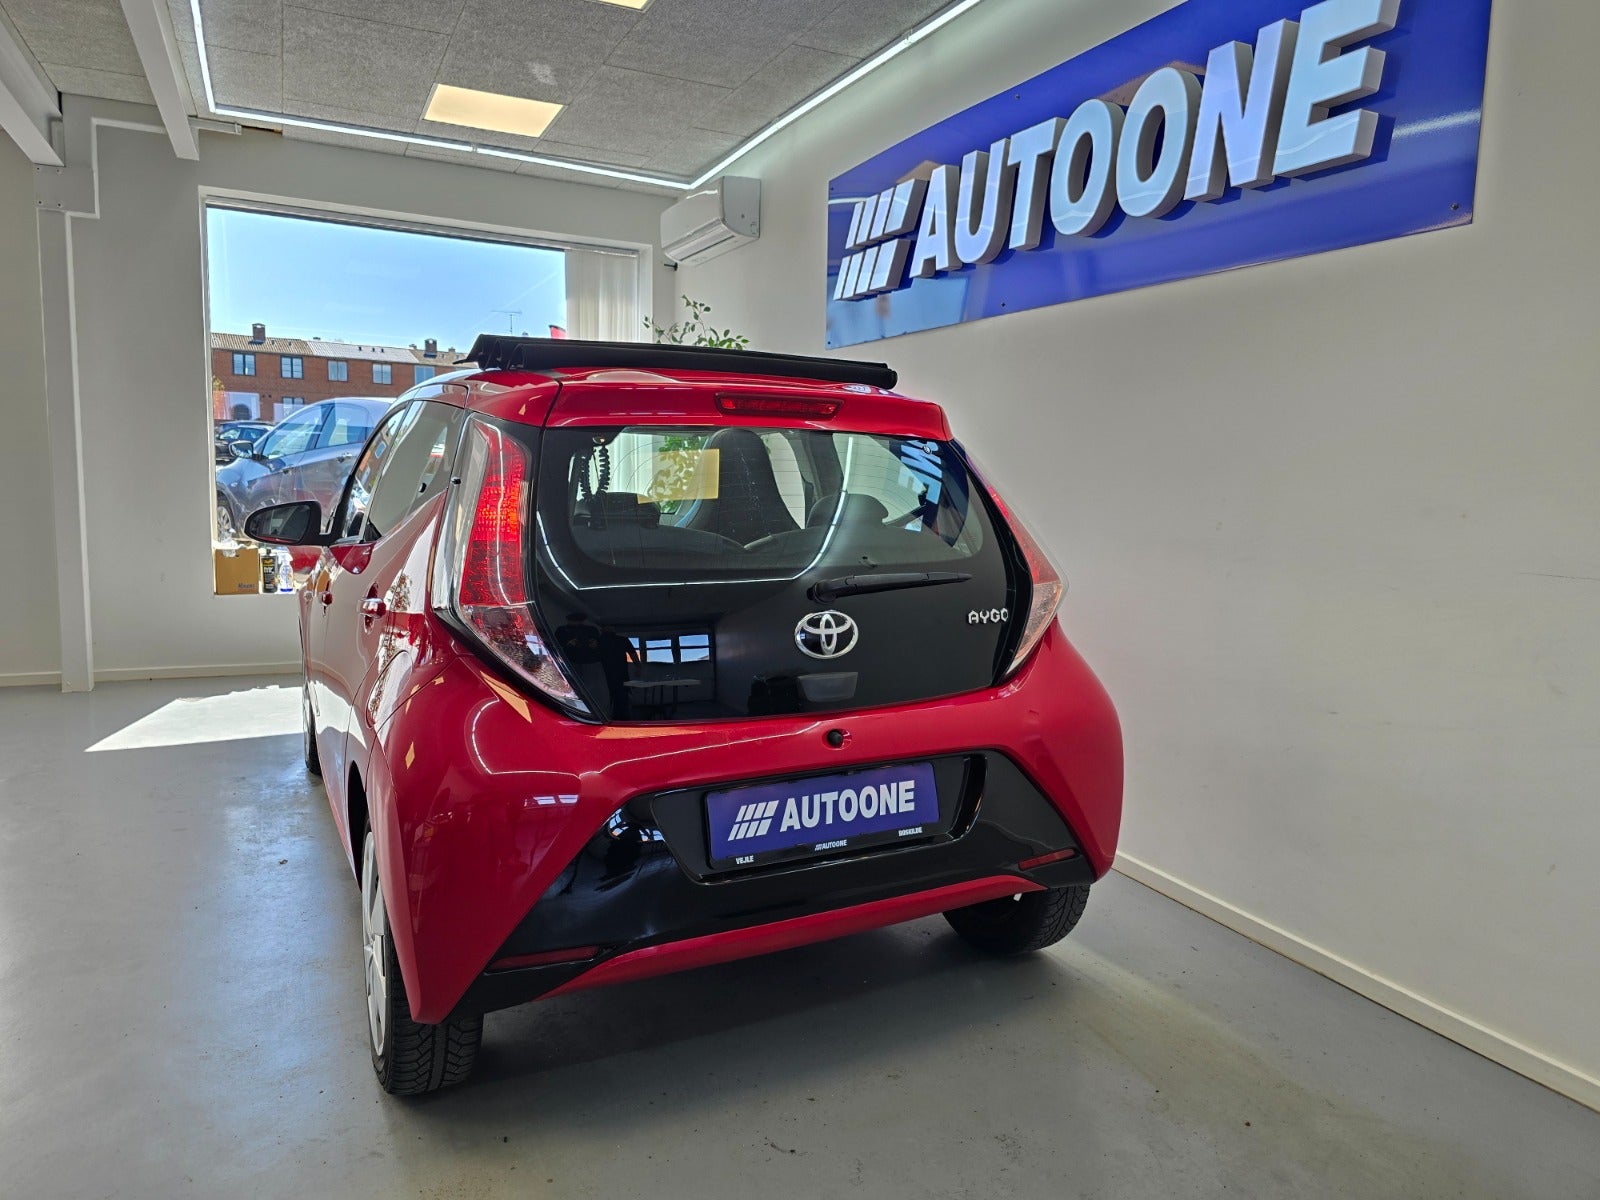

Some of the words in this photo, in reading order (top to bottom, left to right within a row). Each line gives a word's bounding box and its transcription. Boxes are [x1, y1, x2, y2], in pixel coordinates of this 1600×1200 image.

[910, 0, 1400, 279] AUTOONE
[967, 607, 1009, 625] AYGO
[779, 779, 915, 833] AUTOONE
[821, 839, 848, 850] AUTOONE
[735, 855, 755, 865] VEJLE
